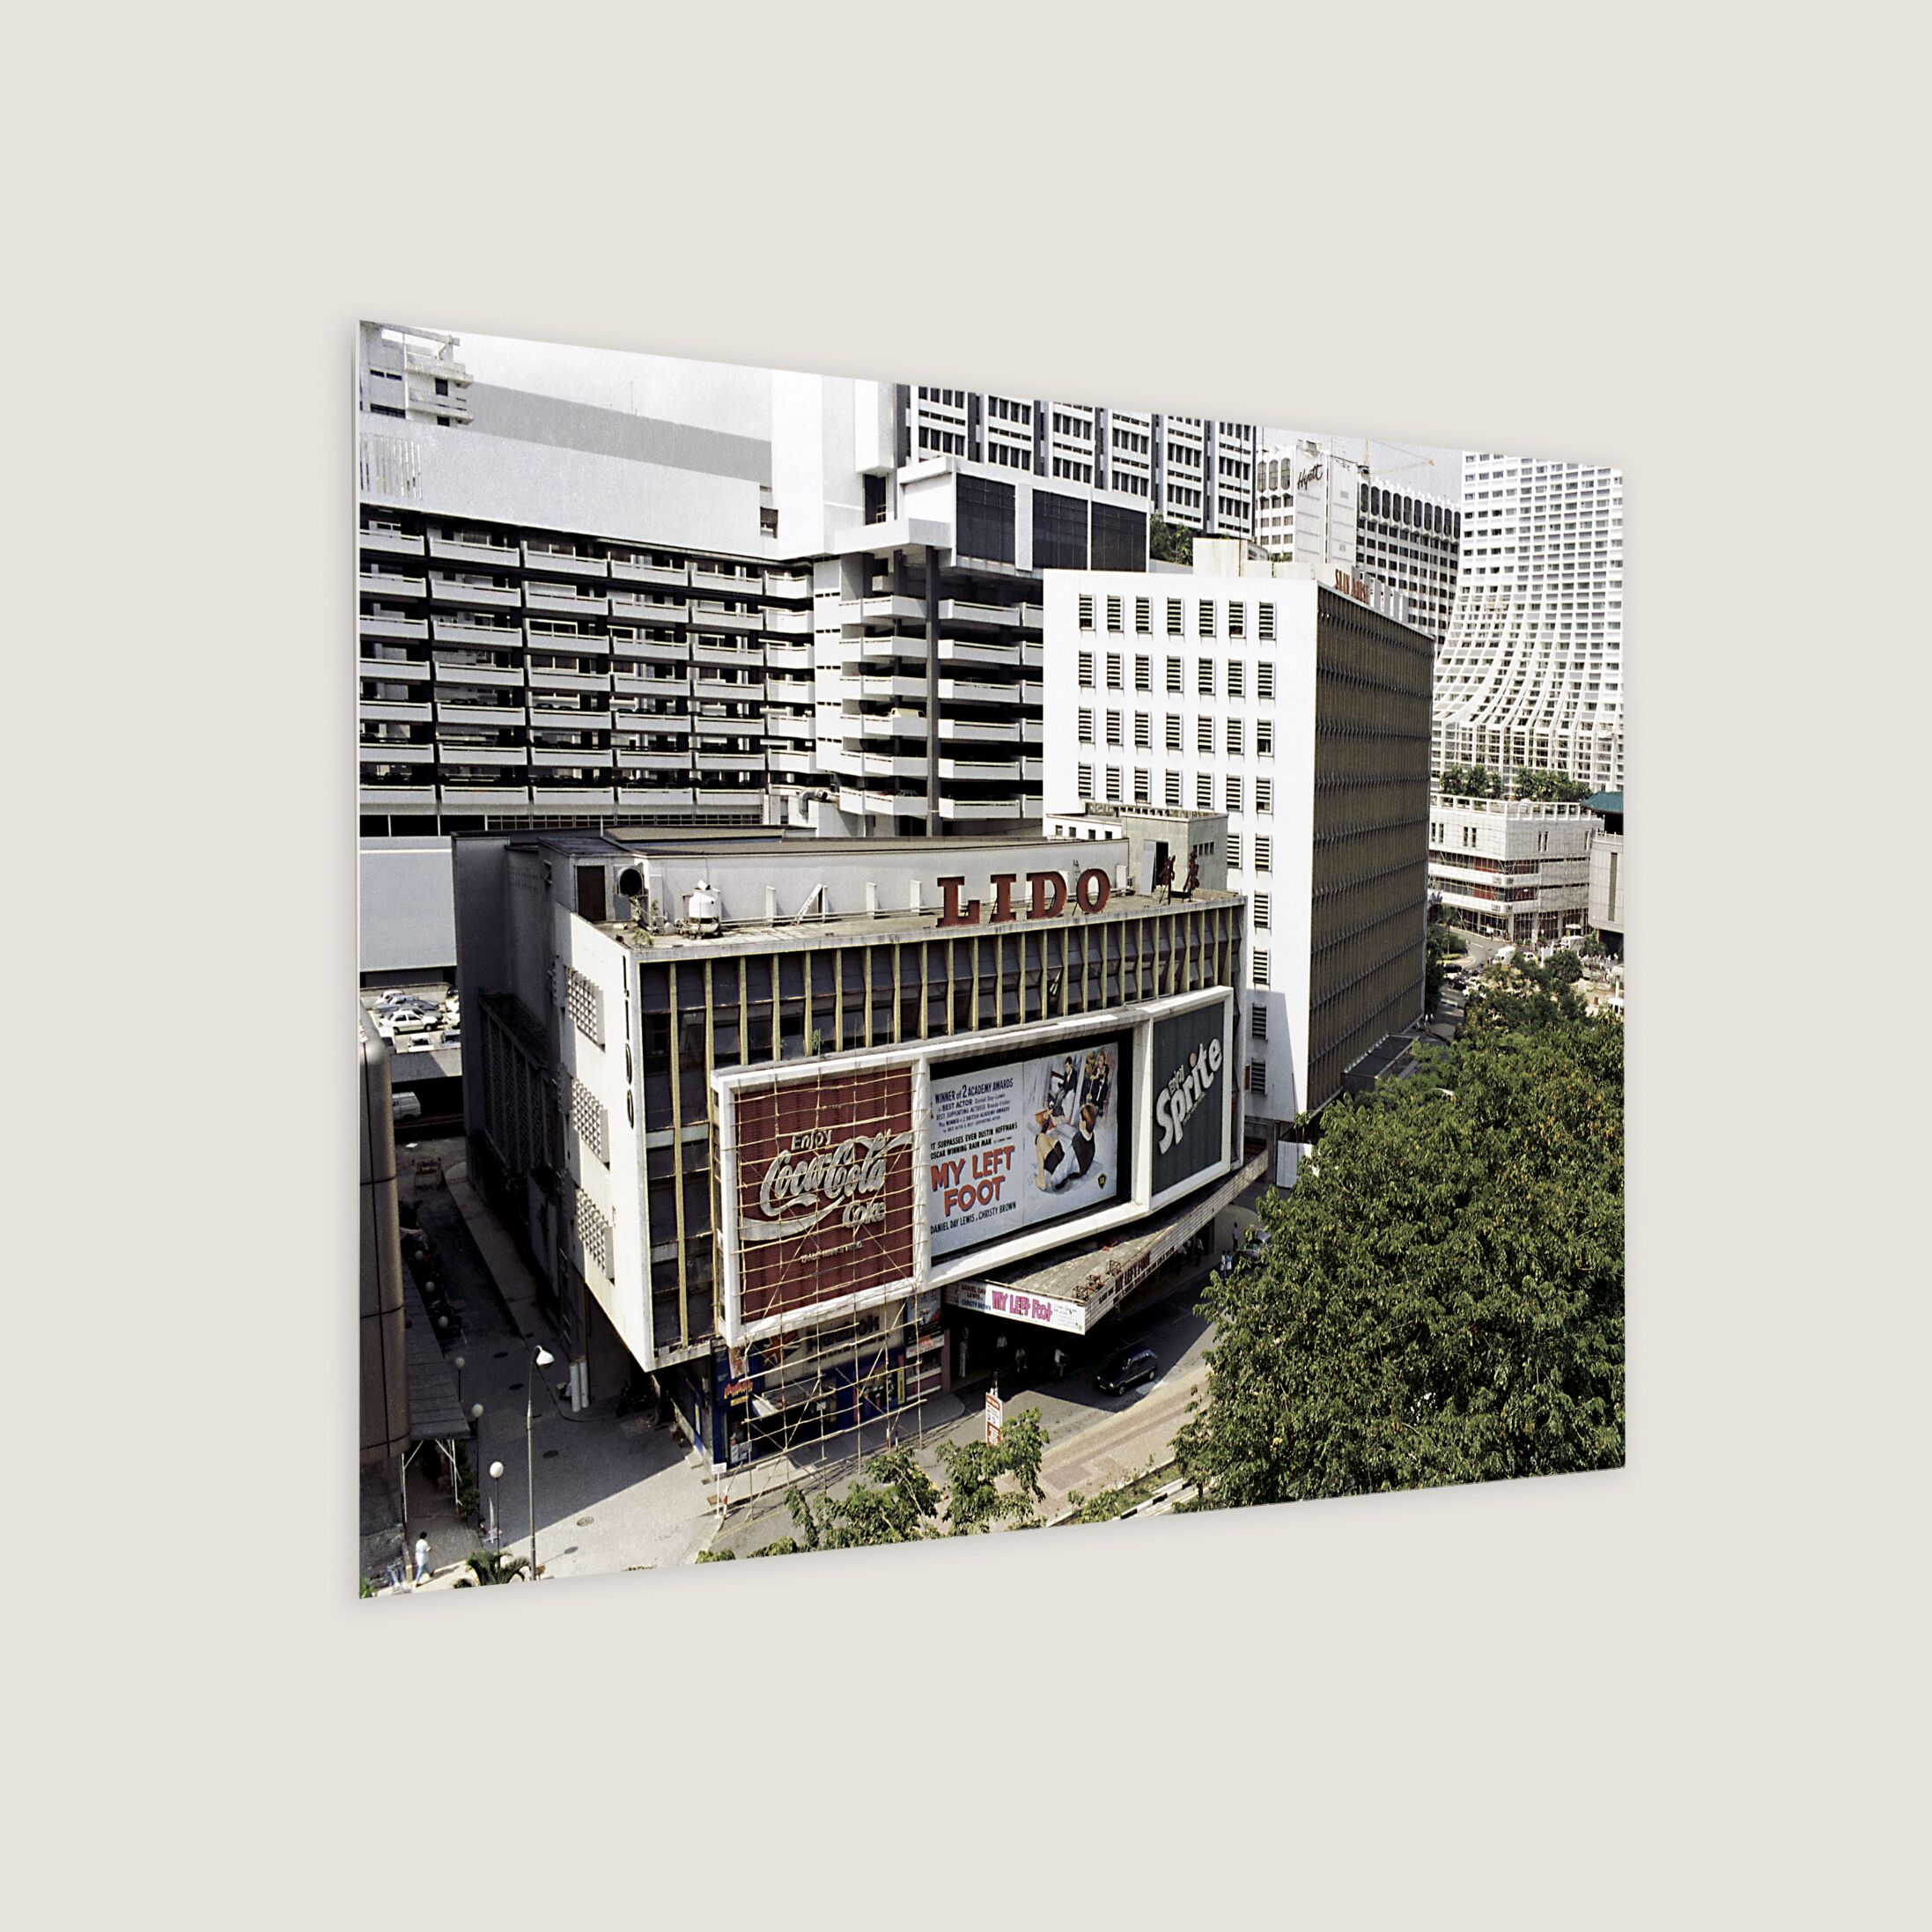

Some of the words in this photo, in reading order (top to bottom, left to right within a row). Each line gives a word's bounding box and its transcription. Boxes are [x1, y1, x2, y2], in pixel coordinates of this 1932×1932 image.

[1297, 463, 1324, 491] Hyatt
[937, 868, 1110, 927] LIDO
[935, 1090, 955, 1104] WINNER
[962, 1085, 967, 1098] 2
[968, 1081, 992, 1096] ACADEMY
[992, 1078, 1014, 1091] AWARDS
[942, 1102, 955, 1111] BEST
[955, 1099, 973, 1108] ACTOR
[1156, 1038, 1222, 1154] Sprite
[947, 1108, 969, 1118] SUPPORTING
[791, 1130, 832, 1151] Enjoy
[931, 1150, 946, 1160] OSCAR
[947, 1145, 967, 1156] WINNING
[969, 1140, 980, 1150] RAIN
[981, 1138, 992, 1147] MAN
[938, 1136, 963, 1149] SURPASSES
[965, 1133, 977, 1142] EVEN
[978, 1128, 994, 1138] DUSTIN
[760, 1131, 888, 1216] Coca-Cola
[931, 1158, 966, 1192] MY
[972, 1145, 1015, 1179] LEFT
[944, 1175, 1006, 1217] FOOT
[843, 1200, 886, 1228] Coke
[930, 1221, 949, 1235] DANIEL
[950, 1218, 960, 1229] DAY
[960, 1213, 975, 1226] LEWIS
[978, 1206, 999, 1220] CHRISTY
[999, 1201, 1017, 1213] BROWN
[992, 1289, 1008, 1311] MY
